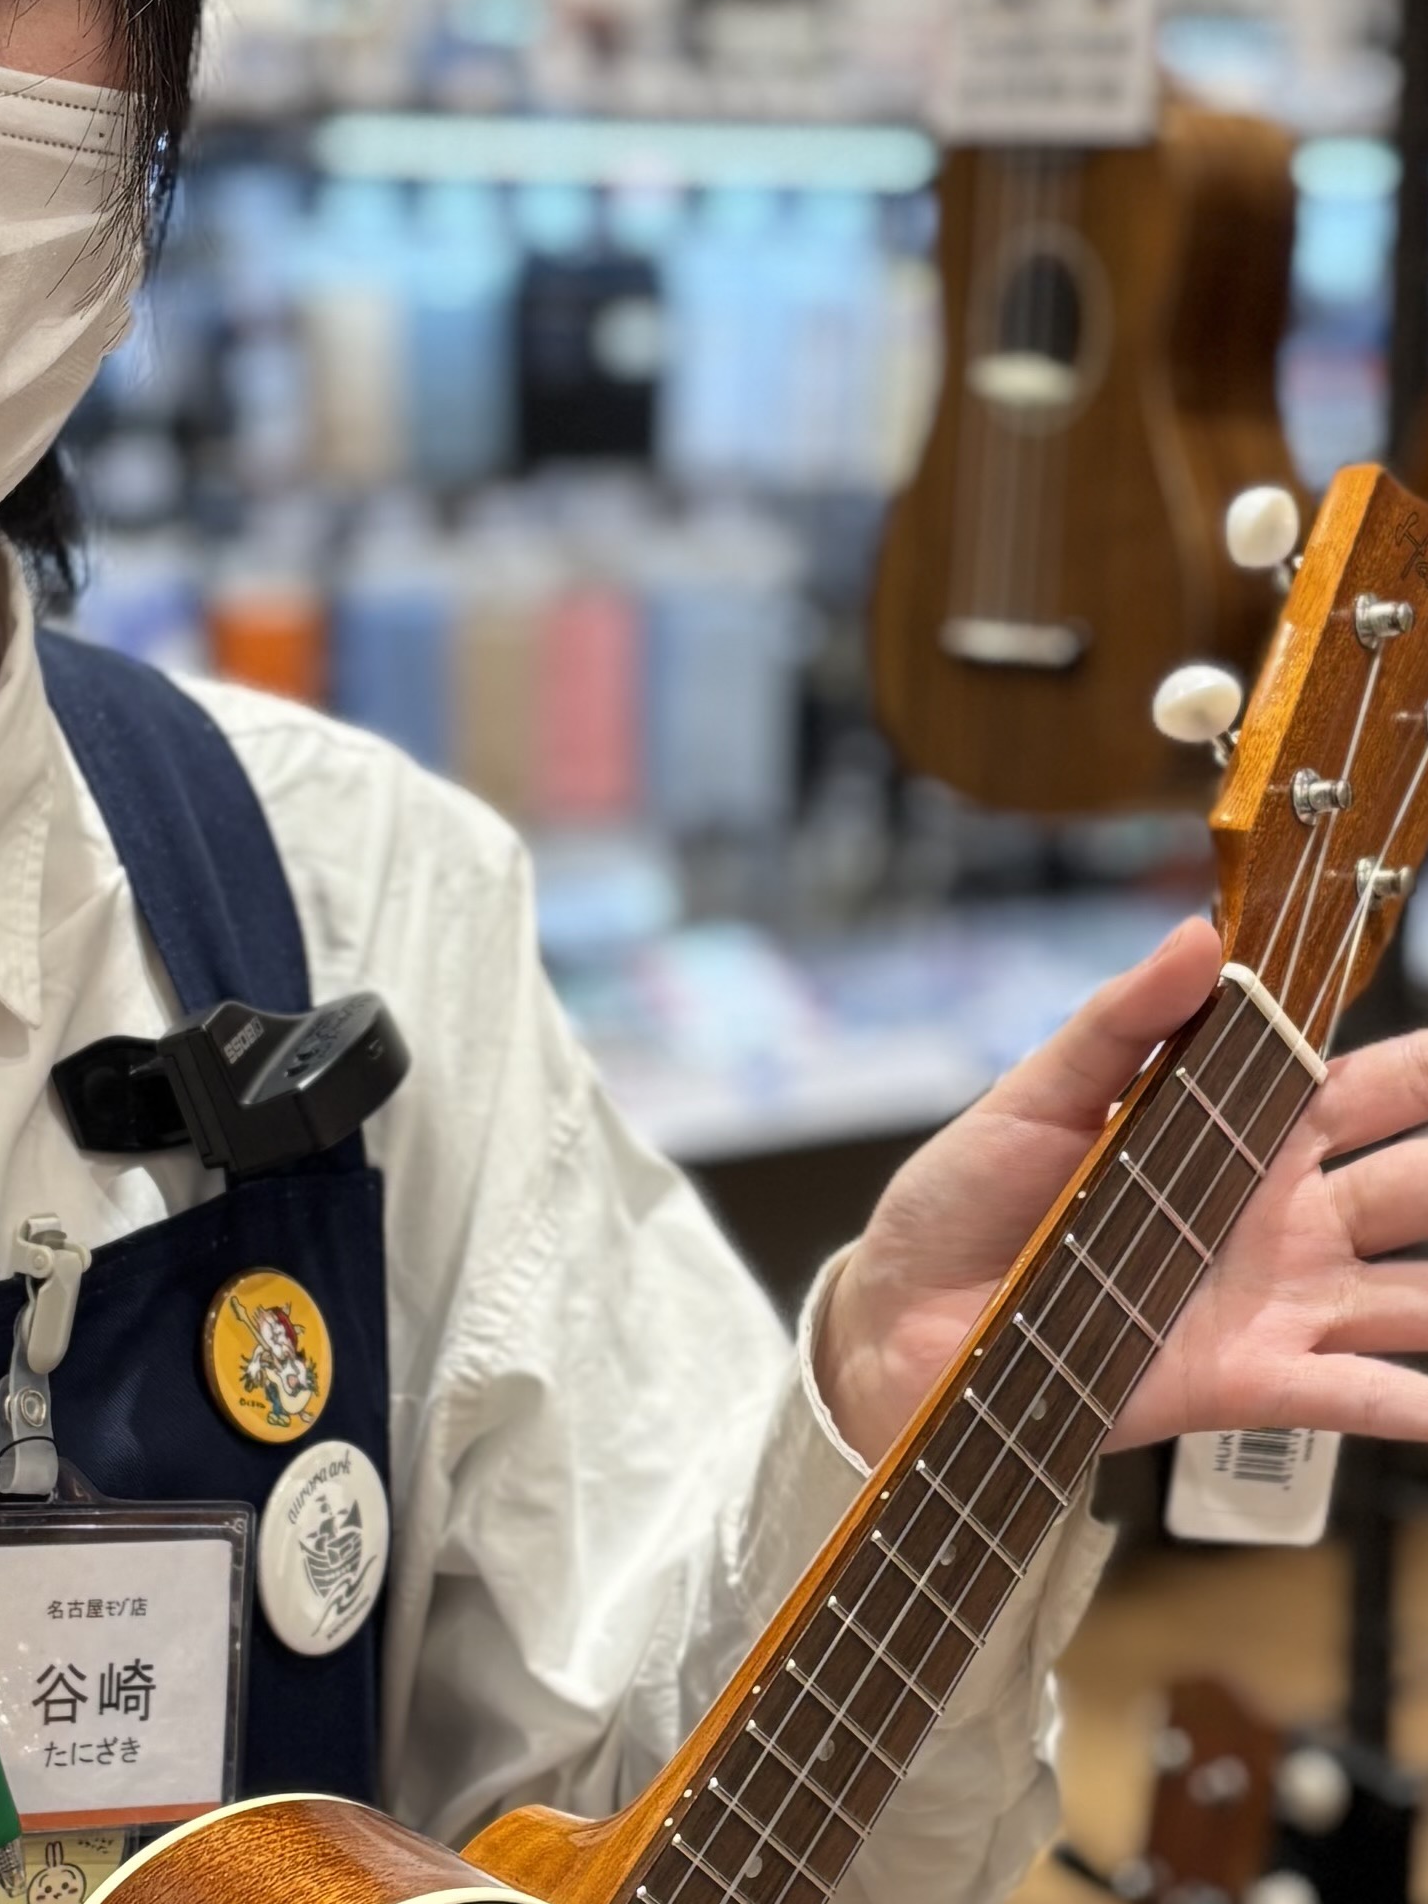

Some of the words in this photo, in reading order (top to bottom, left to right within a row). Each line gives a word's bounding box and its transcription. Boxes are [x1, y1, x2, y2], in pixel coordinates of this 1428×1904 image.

[329, 1448, 352, 1478] ark
[32, 1658, 157, 1726] 谷崎
[44, 1737, 141, 1768] たにざき
